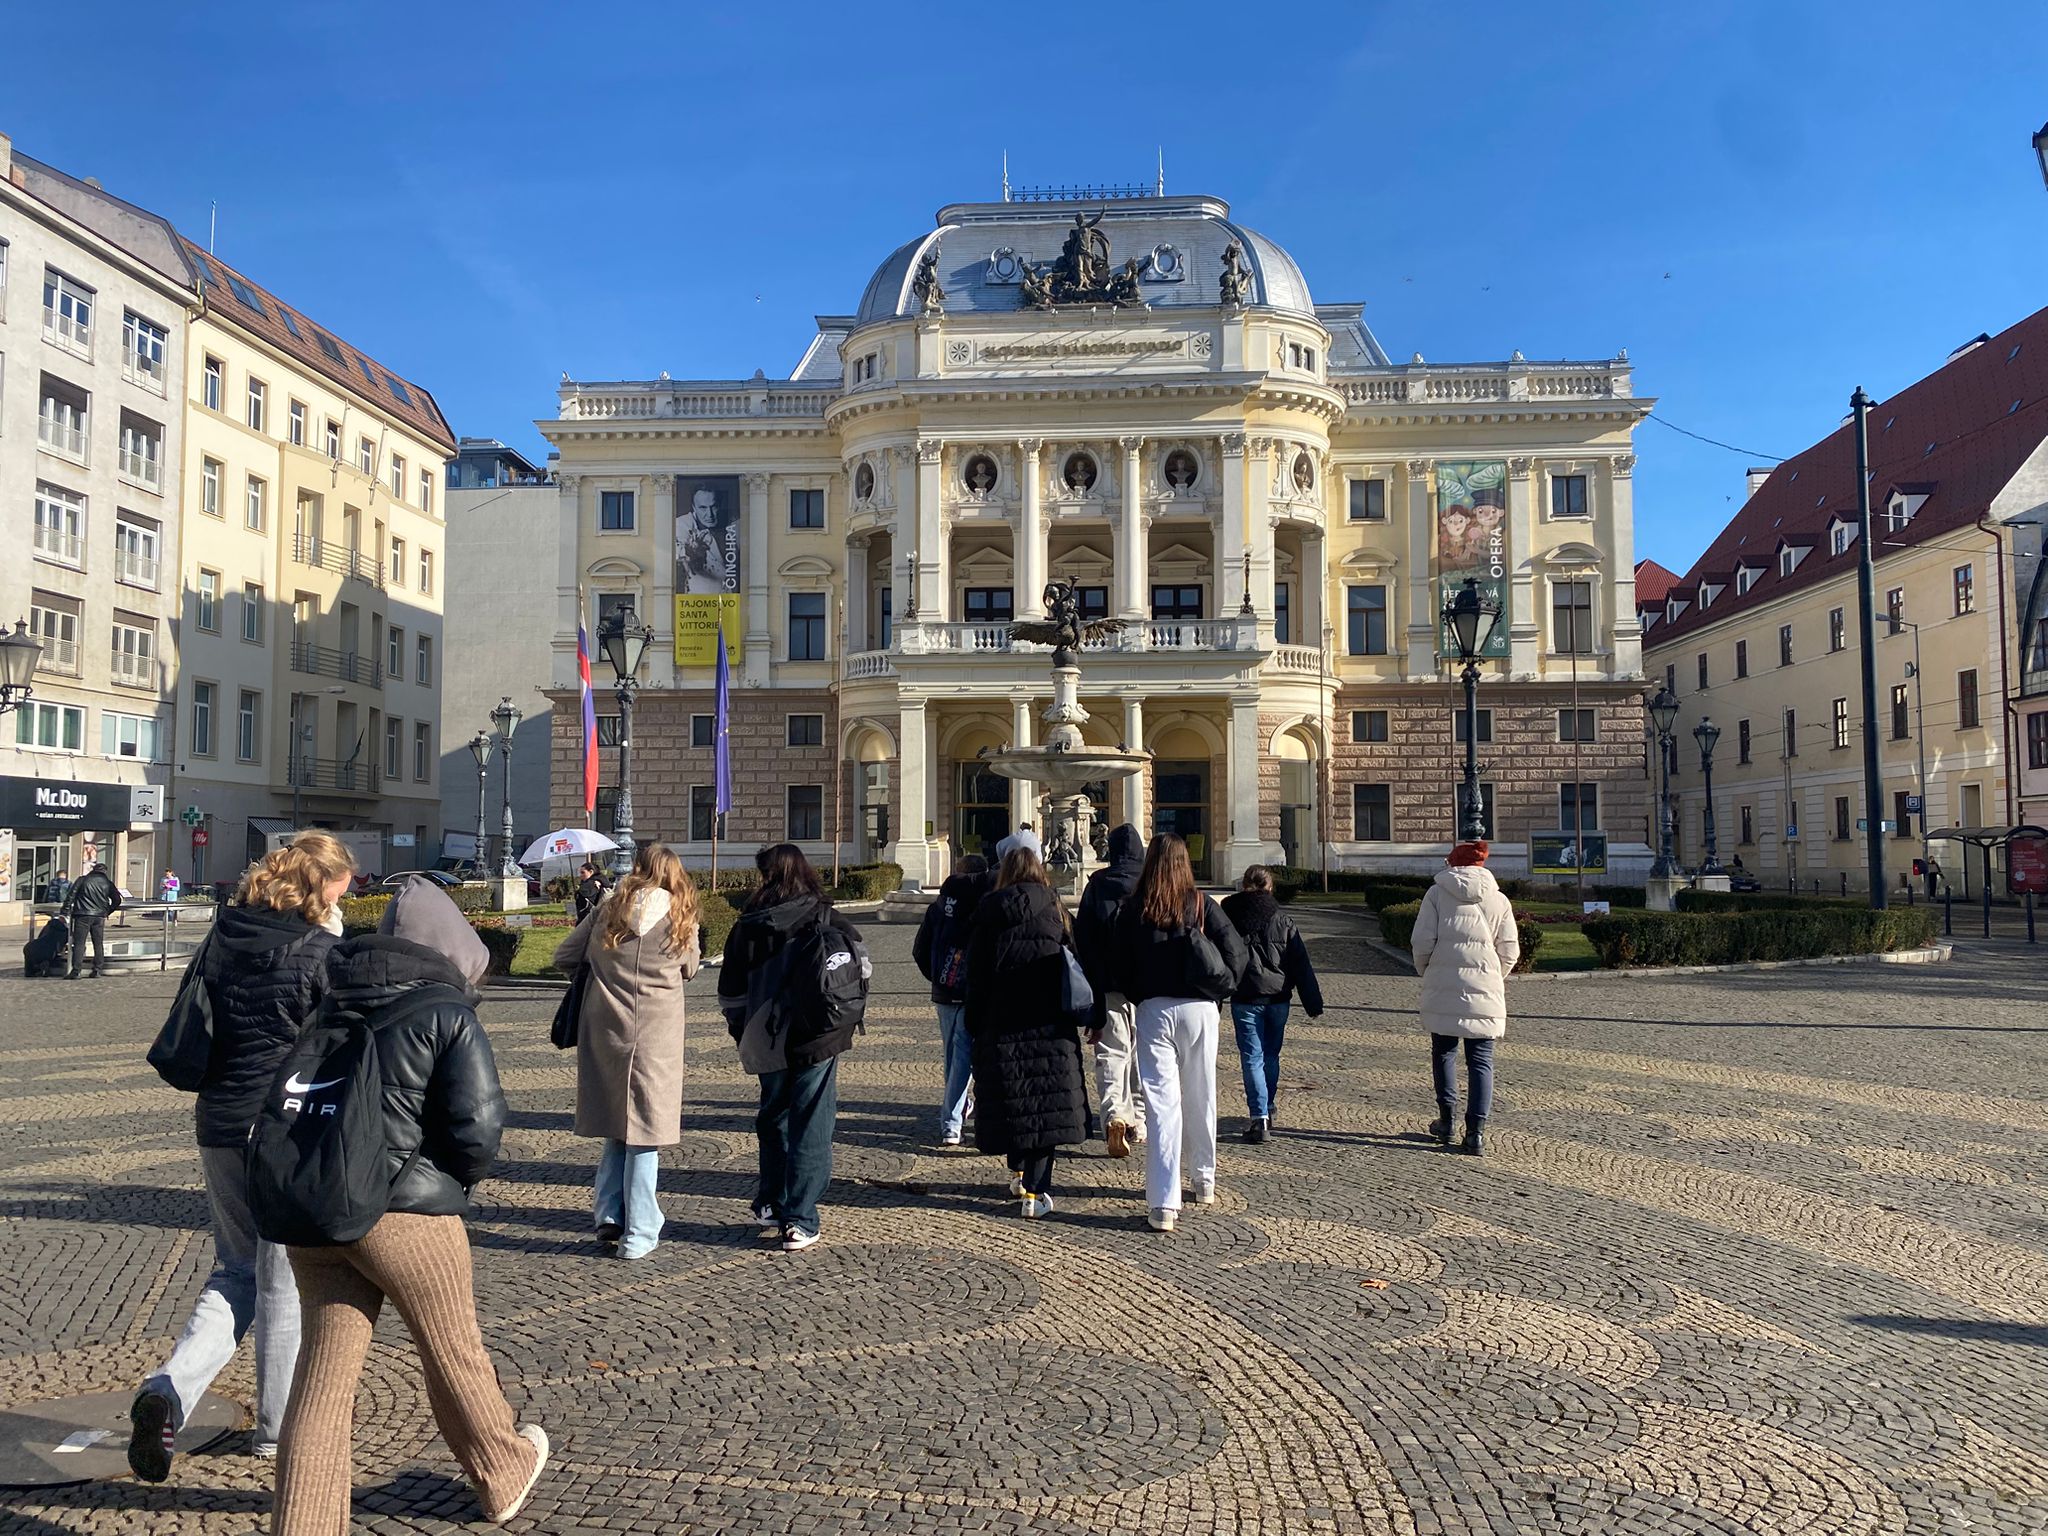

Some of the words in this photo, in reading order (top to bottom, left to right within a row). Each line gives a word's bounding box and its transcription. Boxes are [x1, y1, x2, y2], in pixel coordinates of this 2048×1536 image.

[722, 524, 737, 589] ČINOHRA
[1490, 527, 1503, 578] OPERA
[680, 600, 736, 608] TAJOMSVO
[680, 621, 720, 629] VITTORIE
[283, 1098, 337, 1115] AIR
